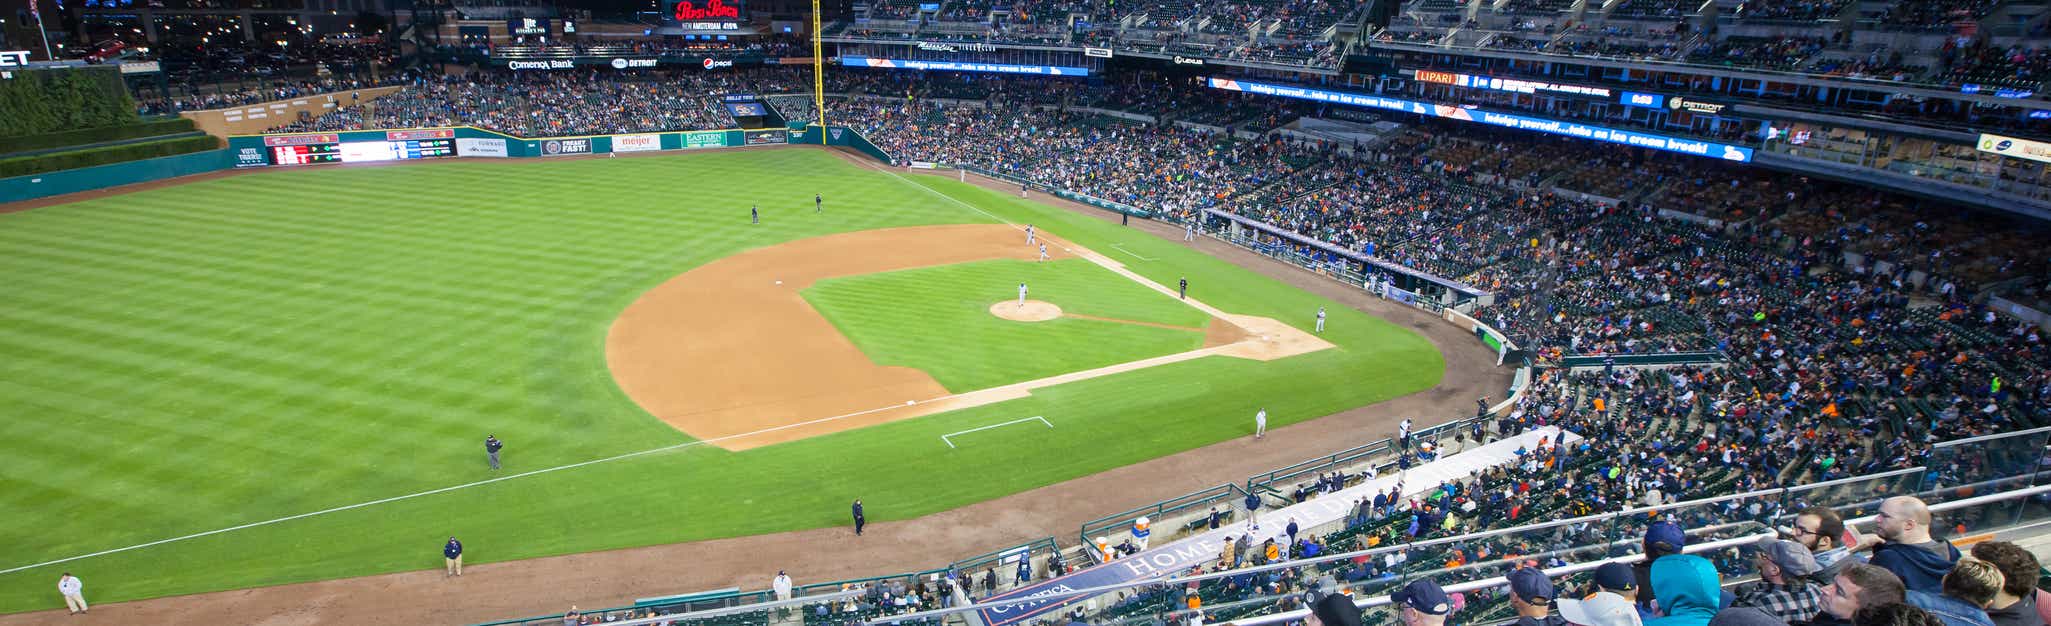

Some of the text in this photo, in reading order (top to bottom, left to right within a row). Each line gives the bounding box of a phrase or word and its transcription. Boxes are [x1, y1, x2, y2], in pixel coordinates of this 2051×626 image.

[693, 22, 721, 30] AMSTERDAM
[551, 60, 574, 68] Bank
[629, 59, 658, 67] DETROIT
[1420, 72, 1452, 84] LIPARI
[1354, 96, 1378, 106] cream
[1380, 98, 1404, 110] break!
[1683, 101, 1725, 110] DETROIT
[622, 135, 650, 146] meijer
[686, 133, 721, 142] EASTERN
[1594, 131, 1608, 139] an
[1610, 130, 1627, 142] ice
[1629, 134, 1666, 147] cream
[1667, 138, 1708, 153] break!
[562, 145, 586, 153] FAST!
[1124, 538, 1218, 577] HOME
